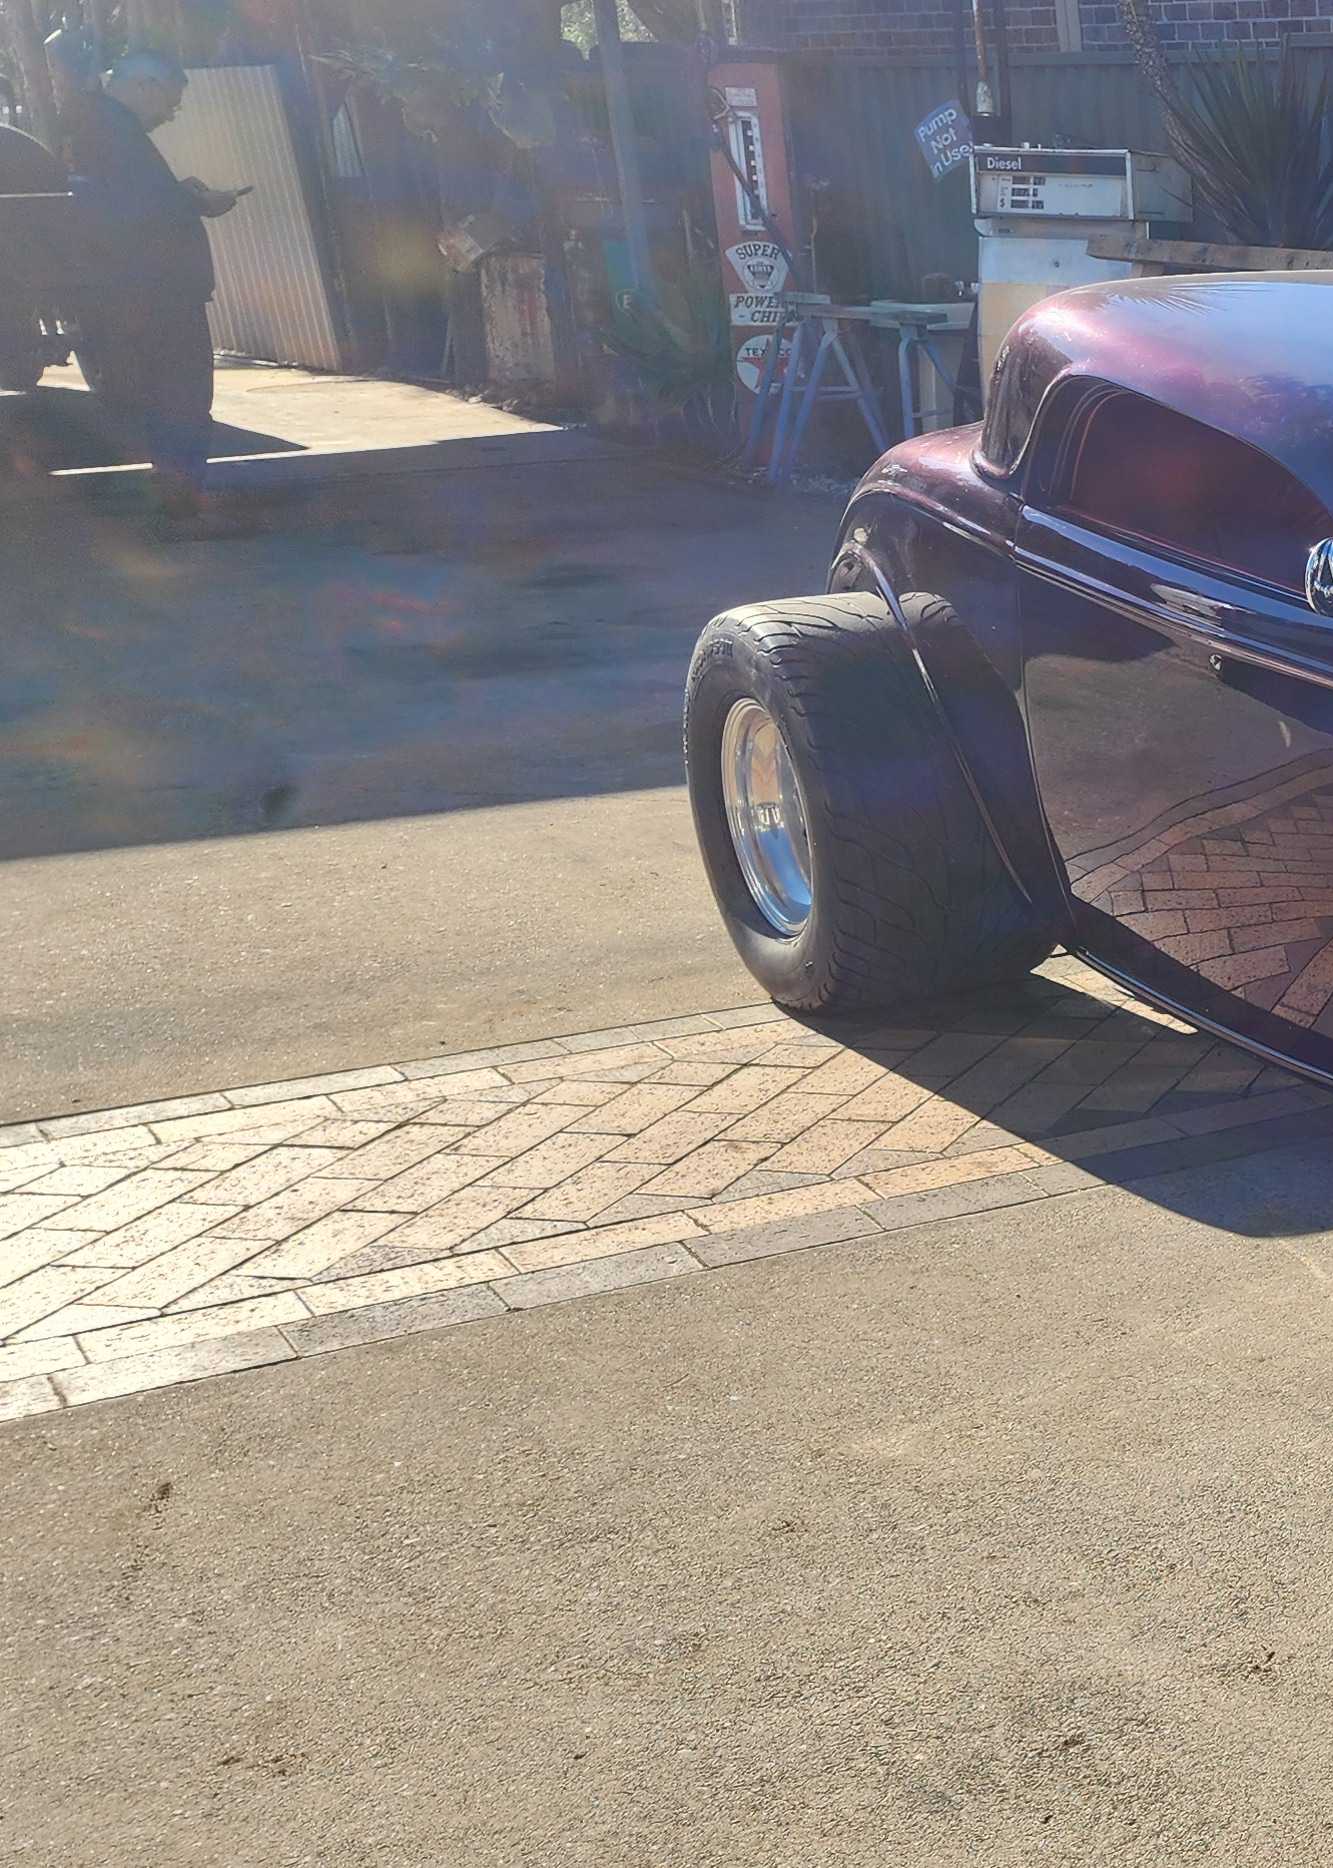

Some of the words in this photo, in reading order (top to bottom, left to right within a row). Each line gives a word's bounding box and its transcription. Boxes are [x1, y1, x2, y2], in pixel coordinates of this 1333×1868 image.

[918, 108, 957, 142] Pump
[931, 127, 957, 155] Not
[987, 157, 1022, 170] Diesel
[736, 243, 780, 261] SUPER
[751, 310, 787, 323] CHI
[745, 347, 793, 357] TEXCO
